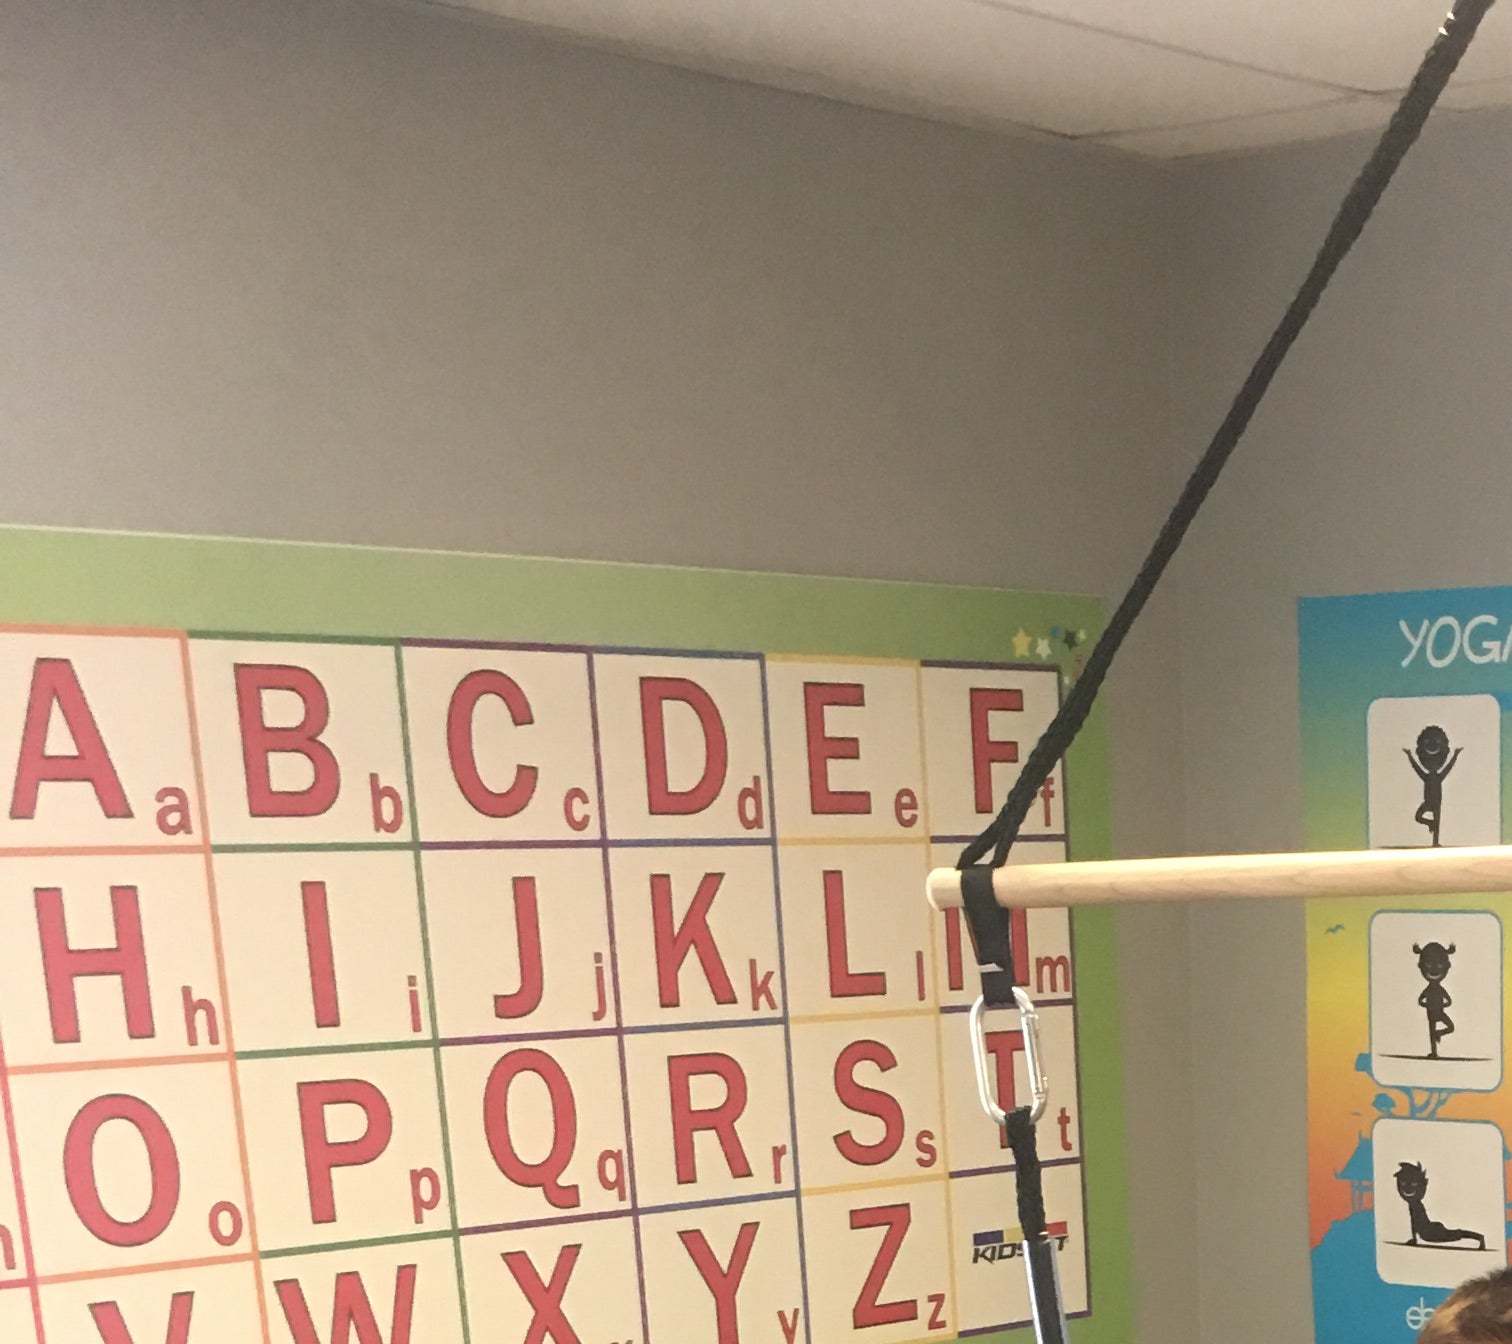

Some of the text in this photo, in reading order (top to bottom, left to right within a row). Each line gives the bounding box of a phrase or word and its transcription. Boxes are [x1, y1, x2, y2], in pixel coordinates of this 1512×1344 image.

[10, 658, 134, 819] A
[155, 787, 193, 835] a
[233, 663, 341, 818] B
[369, 773, 403, 833] b
[446, 669, 538, 818] C
[563, 788, 590, 831] c
[639, 677, 728, 815] D
[738, 776, 764, 830] d
[803, 682, 872, 814] E
[894, 788, 918, 827] e
[34, 885, 155, 1044] H
[181, 986, 219, 1046] h
[494, 876, 544, 1019] J
[650, 872, 738, 1008] K
[749, 959, 777, 1011] k
[823, 870, 886, 1000] L
[1036, 953, 1070, 993] m
[296, 1078, 392, 1224] P
[409, 1166, 441, 1224] p
[483, 1048, 581, 1209] Q
[598, 1149, 626, 1201] q
[667, 1052, 752, 1185] R
[772, 1143, 787, 1184] r
[833, 1039, 904, 1166] S
[1057, 1107, 1072, 1151] t
[849, 1203, 918, 1330] Z
